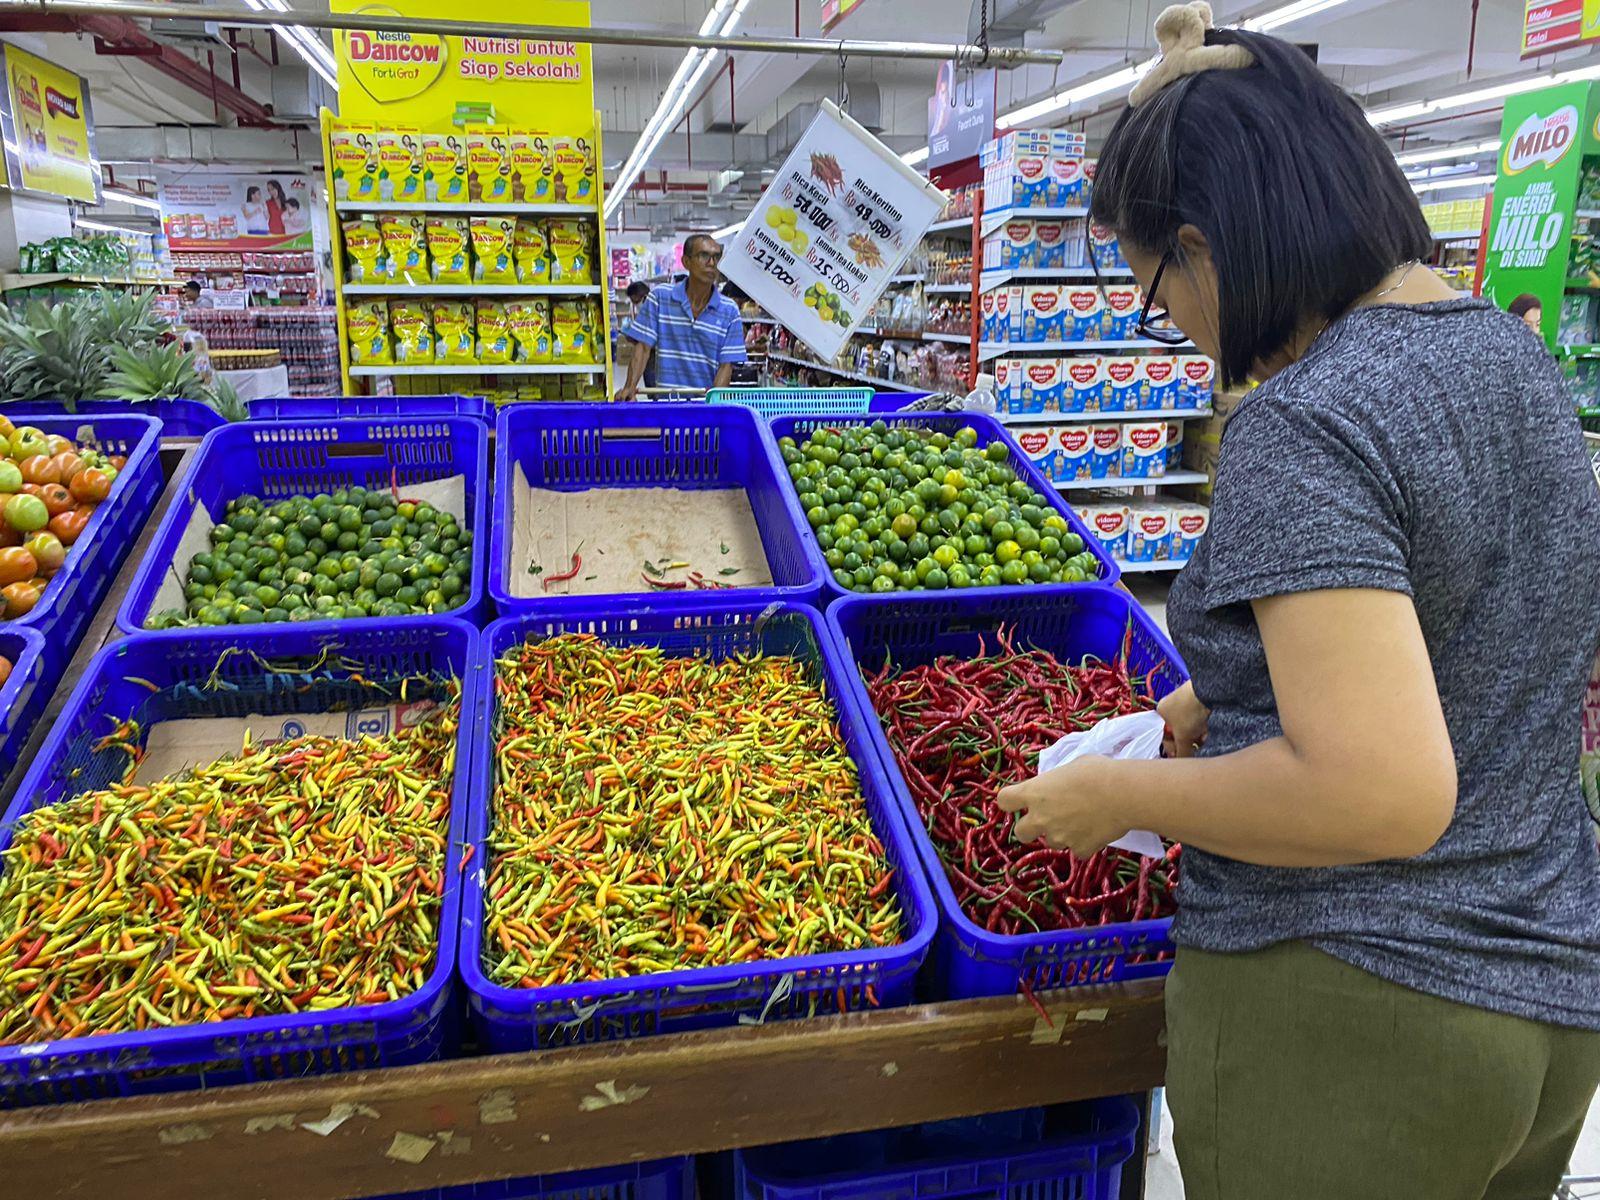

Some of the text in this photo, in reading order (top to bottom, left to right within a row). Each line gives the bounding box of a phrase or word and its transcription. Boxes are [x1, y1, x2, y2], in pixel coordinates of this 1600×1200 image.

[350, 32, 439, 62] Dancow
[464, 38, 575, 56] Nutrisi untuk
[460, 60, 579, 79] Siap Sekolah!
[1513, 125, 1569, 160] MILO
[336, 151, 366, 160] Dancow
[381, 151, 410, 160] Dancow
[426, 153, 455, 162] Dancow
[471, 153, 499, 163] Dancow
[514, 154, 542, 163] Dancow
[556, 154, 584, 163] Dancow
[782, 182, 793, 200] Rp
[792, 171, 829, 205] Rica Kecil
[1524, 181, 1554, 196] AMBIL
[844, 190, 857, 208] Rp
[855, 178, 903, 221] Rica Keriting
[1501, 191, 1557, 217] ENERGI
[1491, 211, 1564, 251] MILO
[746, 238, 757, 255] Rp
[755, 227, 795, 266] Lemon Ikan
[806, 247, 818, 264] Rp
[816, 236, 837, 257] Lemon
[835, 252, 848, 266] Tea
[1499, 249, 1548, 268] DI SINI!
[1021, 436, 1046, 444] vidoran
[1061, 434, 1086, 442] vidoran
[1132, 431, 1158, 440] vidoran
